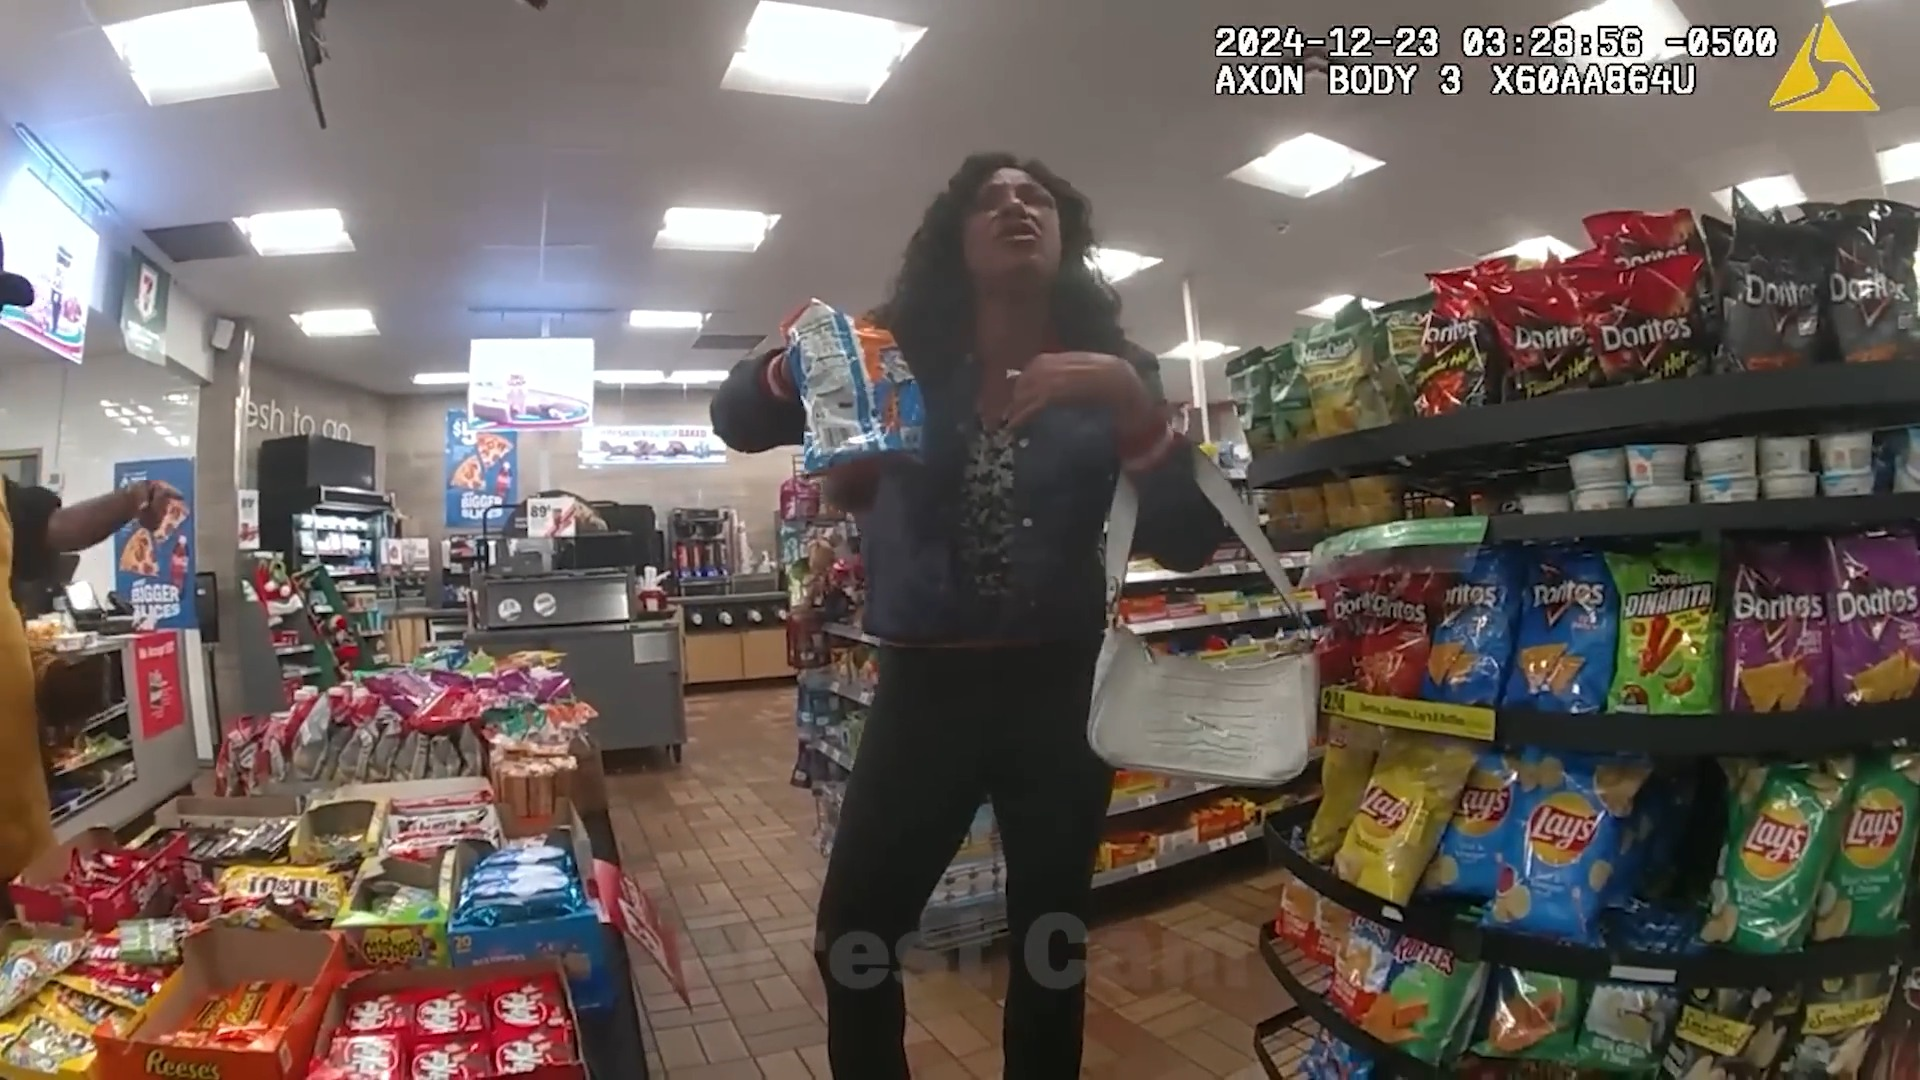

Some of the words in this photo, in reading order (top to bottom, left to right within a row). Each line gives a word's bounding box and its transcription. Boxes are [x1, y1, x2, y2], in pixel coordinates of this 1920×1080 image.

[1602, 316, 1692, 351] Doritos
[293, 406, 315, 436] to
[131, 583, 180, 603] BIGGER
[1533, 579, 1604, 607] Doritos
[1625, 583, 1712, 617] DINAMITA
[1734, 592, 1823, 620] Doritos
[1837, 585, 1917, 622] Doritos
[146, 1050, 220, 1080] Reese's
